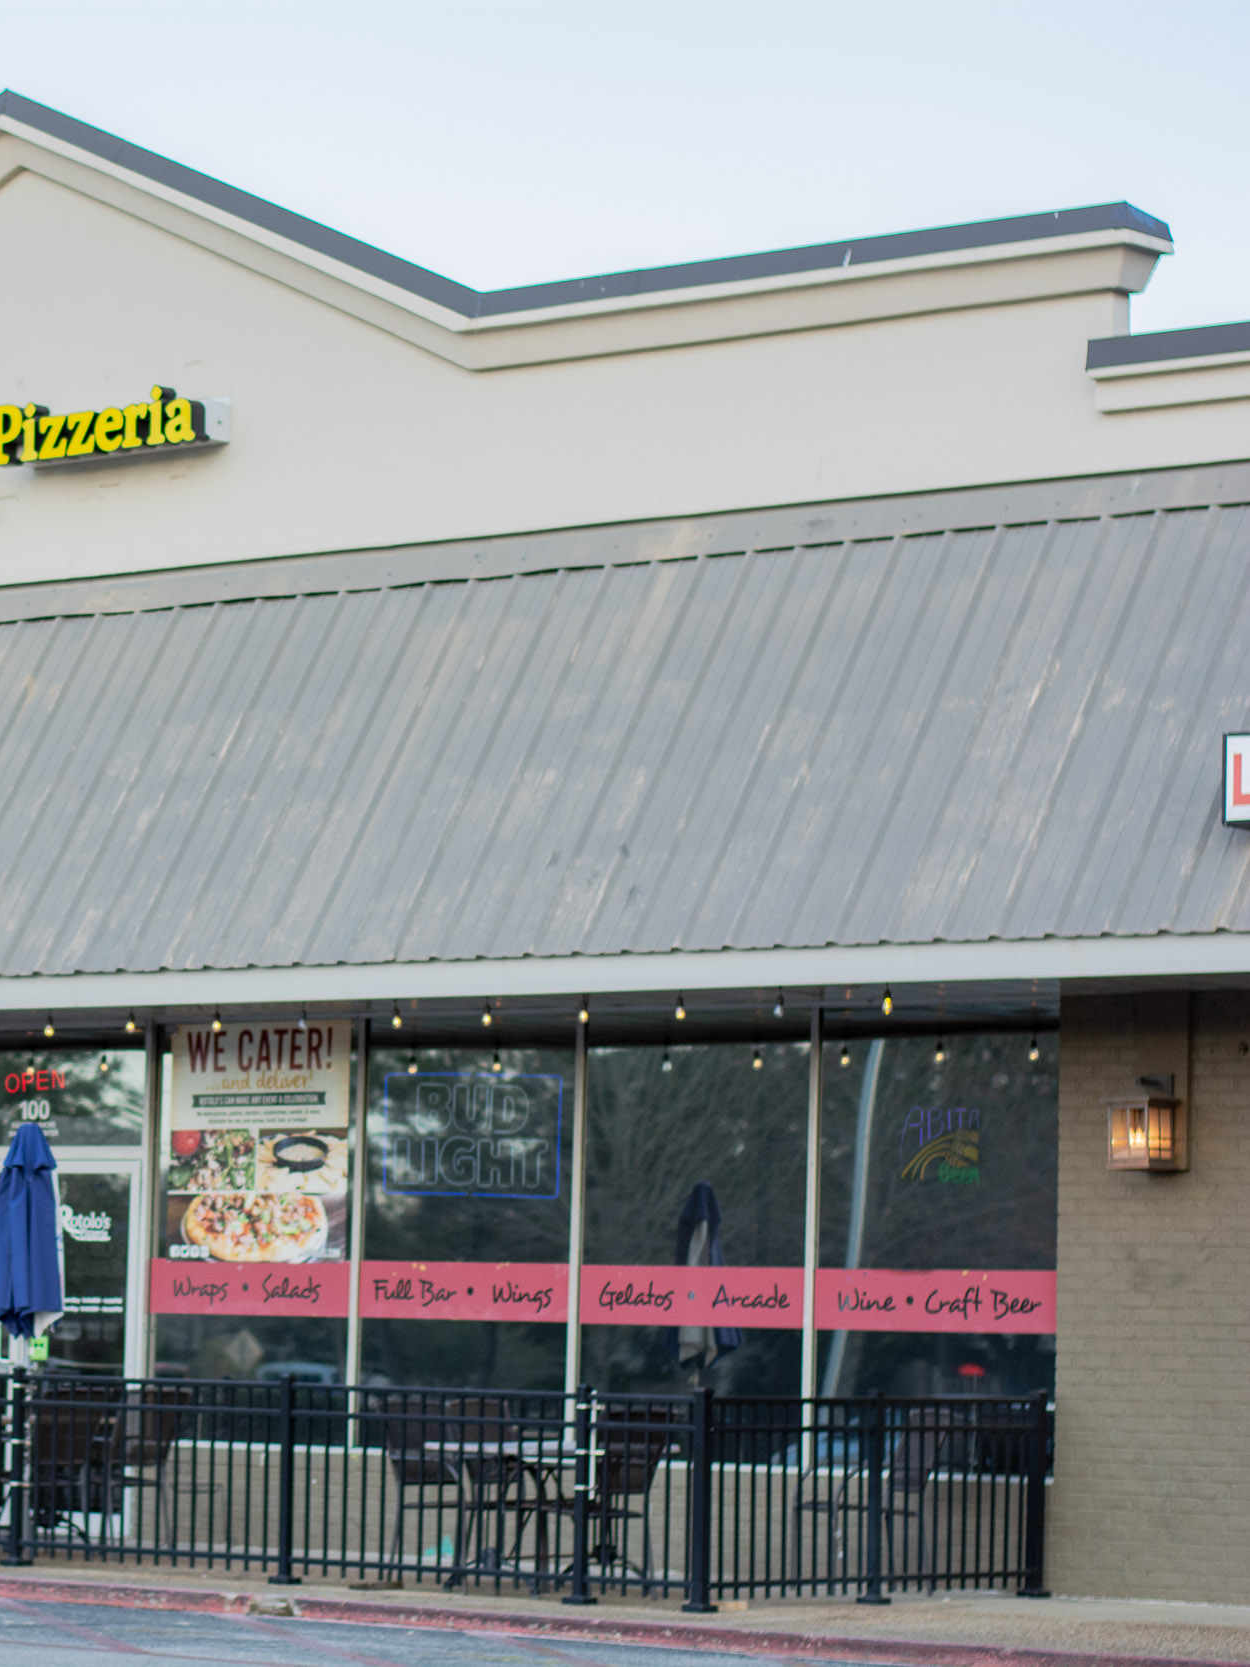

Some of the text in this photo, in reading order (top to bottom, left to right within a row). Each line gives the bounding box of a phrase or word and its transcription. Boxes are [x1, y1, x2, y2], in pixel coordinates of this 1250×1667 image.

[187, 1026, 334, 1073] WE CATER!
[4, 1069, 66, 1094] OPEN
[255, 1068, 314, 1090] deliver!
[19, 1100, 51, 1121] 100
[416, 1082, 530, 1134] BUD
[899, 1105, 980, 1159] ABITA
[393, 1136, 550, 1188] LIGHT
[173, 1273, 322, 1305] Wraps Salads
[373, 1279, 554, 1314] Full Bar Wings
[598, 1280, 791, 1311] Gelatos Arcade
[837, 1285, 1043, 1320] Wine Craft Beer
